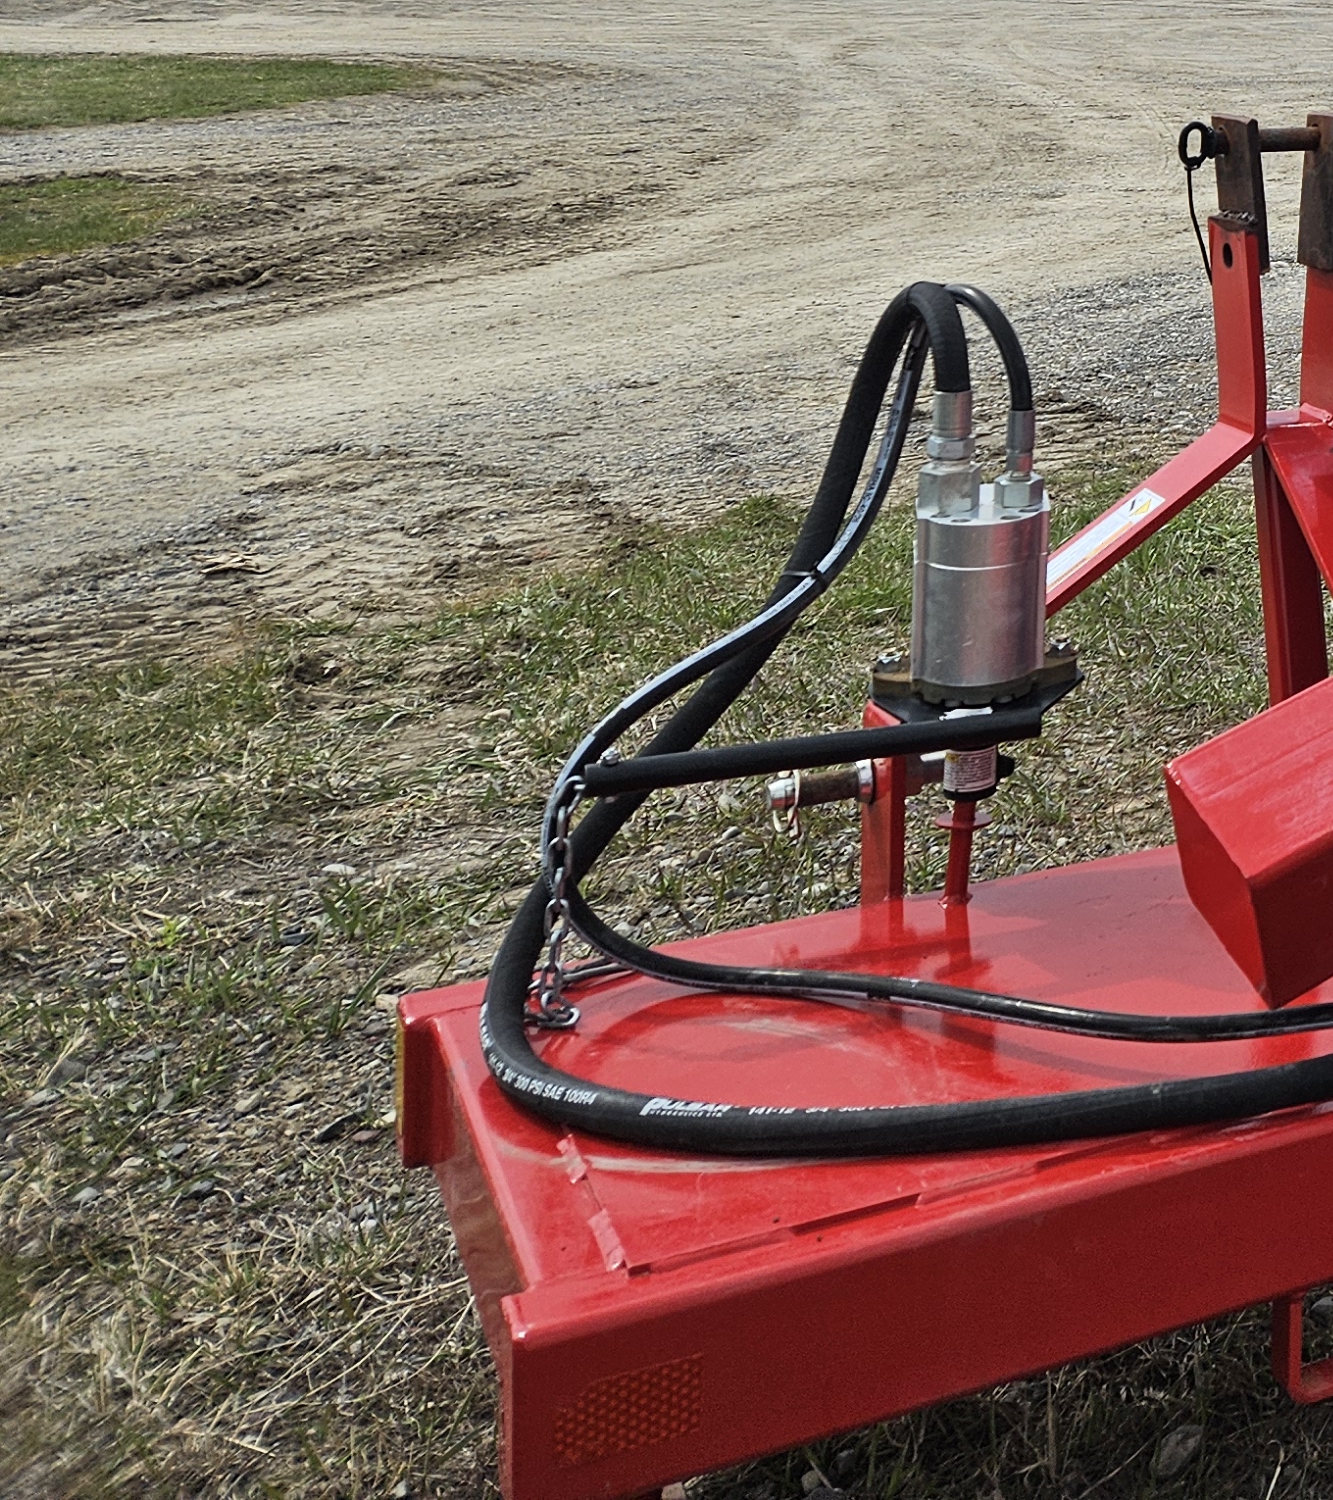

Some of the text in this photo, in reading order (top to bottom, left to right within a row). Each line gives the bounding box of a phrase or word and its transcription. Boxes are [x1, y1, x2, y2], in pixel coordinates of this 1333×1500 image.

[514, 1073, 529, 1092] 300
[528, 1078, 544, 1096] PSI
[542, 1083, 566, 1101] SAE
[563, 1088, 599, 1105] 100R4
